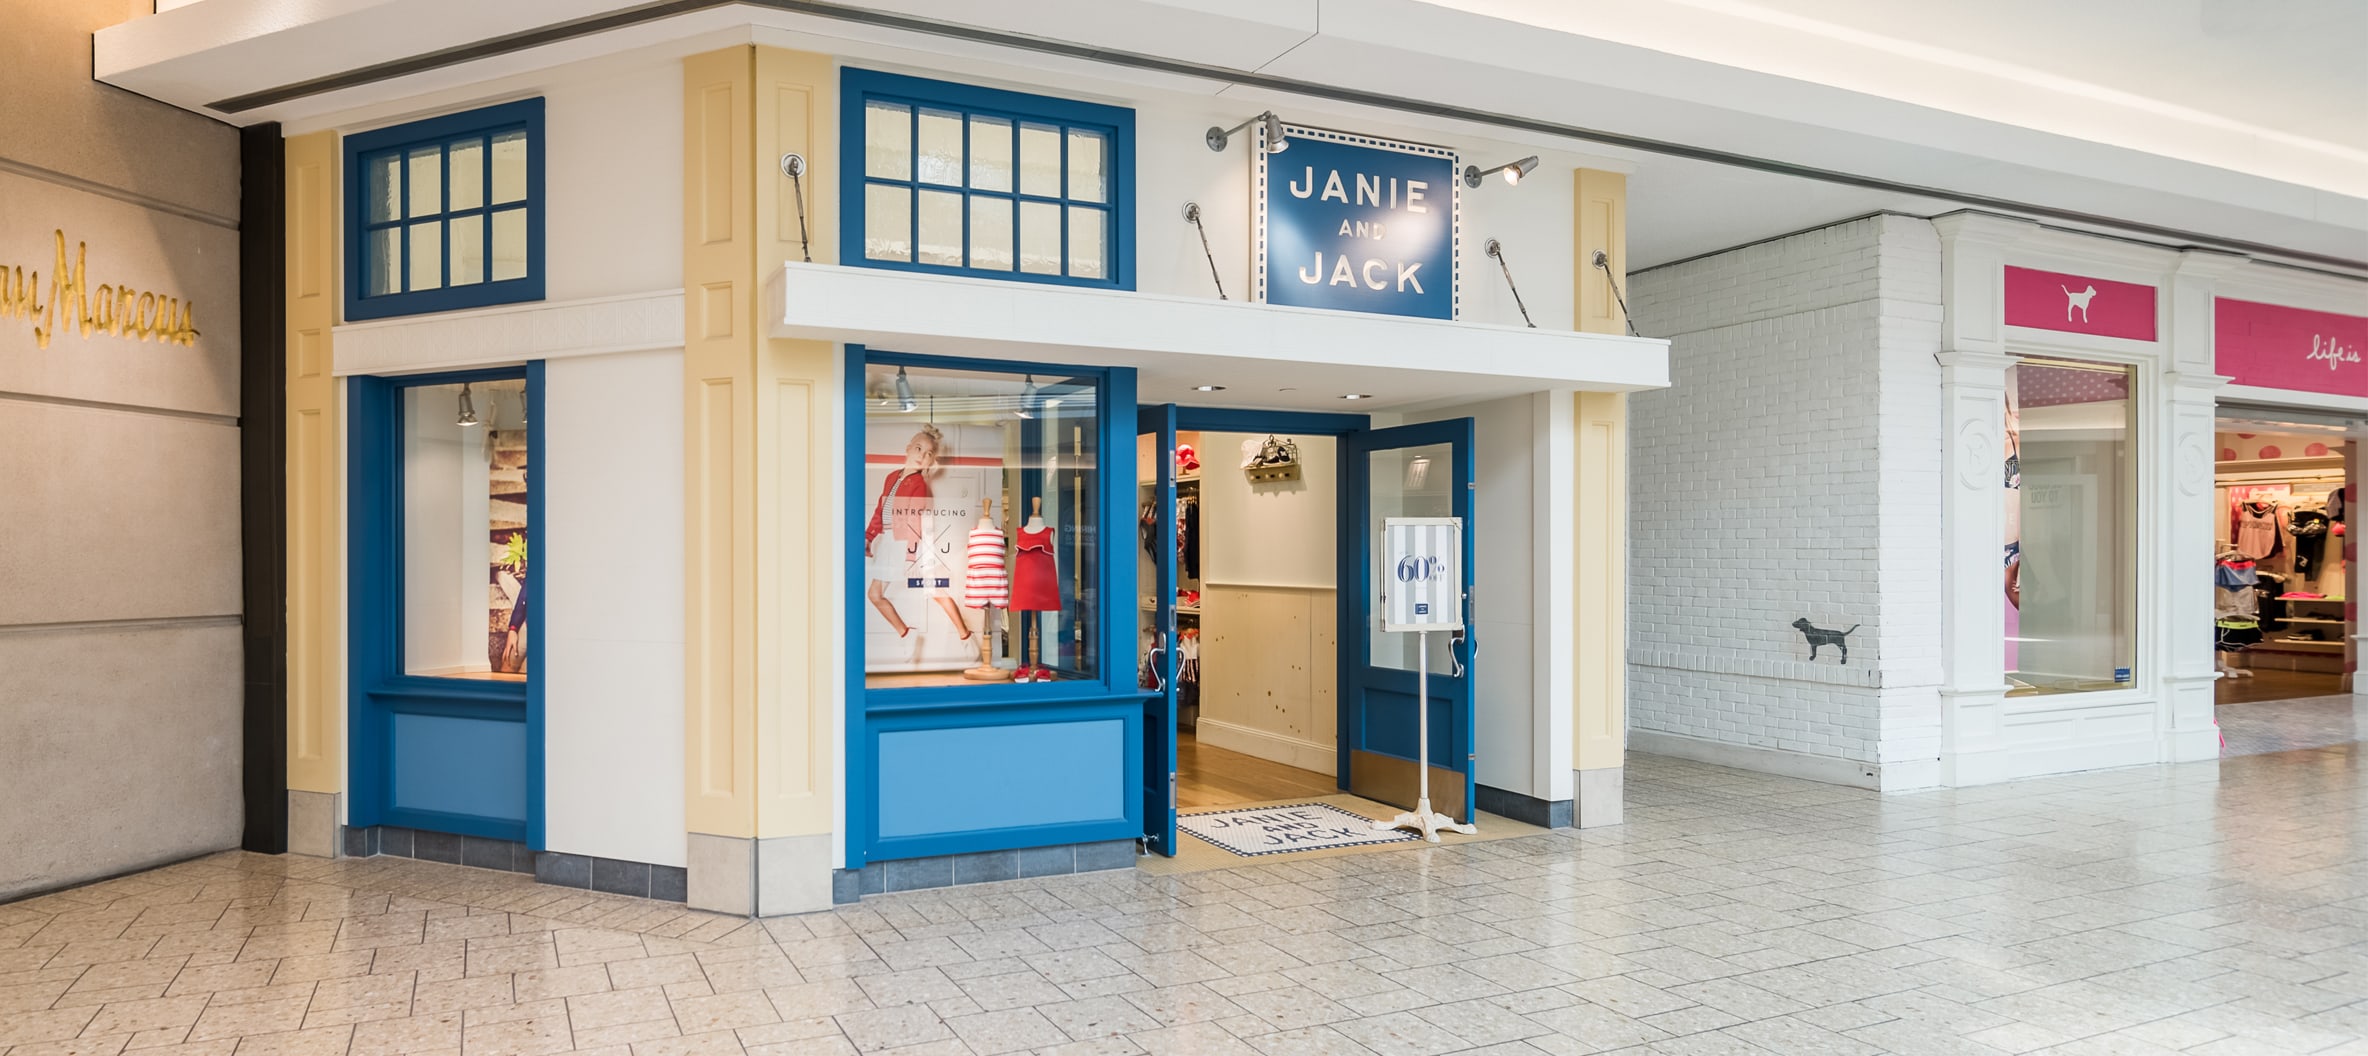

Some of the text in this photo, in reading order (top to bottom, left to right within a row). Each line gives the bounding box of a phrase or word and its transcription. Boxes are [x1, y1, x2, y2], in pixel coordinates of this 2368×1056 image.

[1289, 165, 1428, 214] JANIE
[1338, 218, 1386, 240] AND
[1299, 251, 1425, 294] JACK
[35, 229, 200, 350] Marcus
[2306, 333, 2361, 371] life is
[892, 508, 966, 517] INTRODUCING
[907, 541, 951, 554] J J
[1211, 810, 1322, 829] JANIE
[1262, 821, 1319, 833] AND
[1264, 827, 1367, 845] JACK
